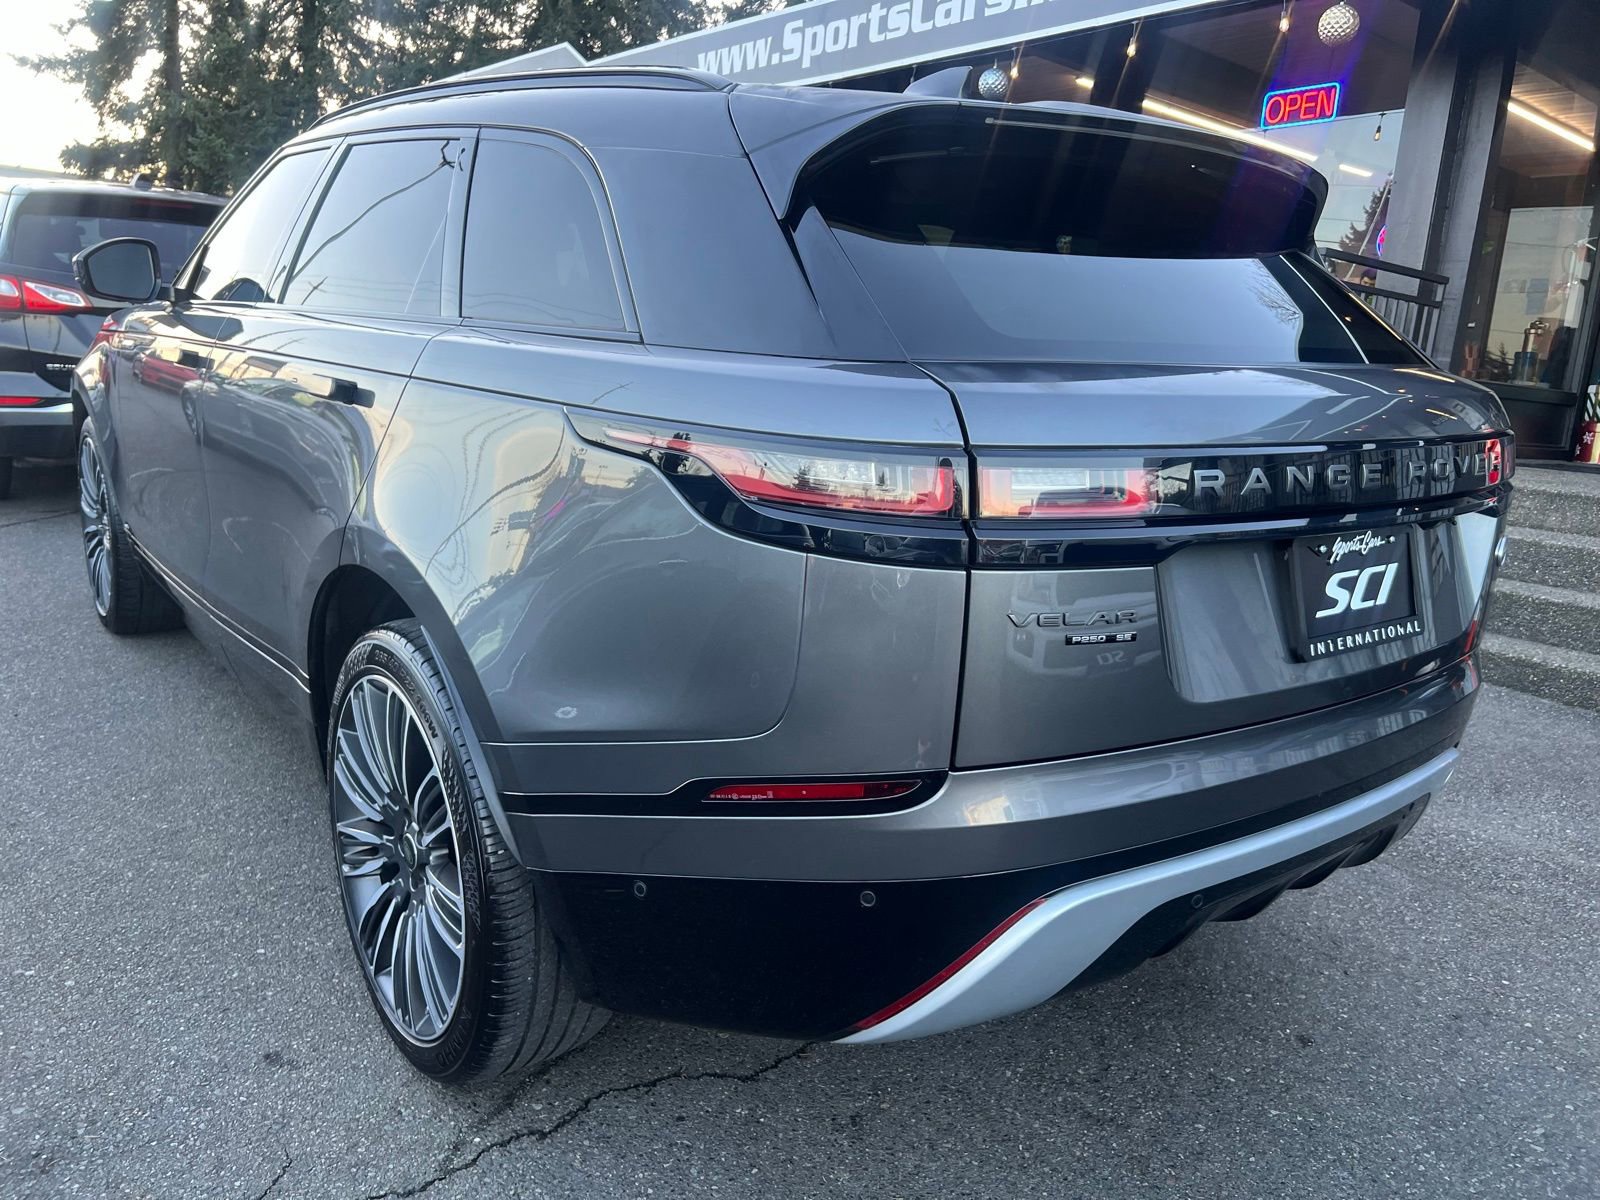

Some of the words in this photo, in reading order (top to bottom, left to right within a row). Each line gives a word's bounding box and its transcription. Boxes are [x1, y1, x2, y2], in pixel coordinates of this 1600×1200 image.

[698, 0, 1053, 75] www.SportsCar
[1266, 88, 1336, 124] OPEN
[1193, 463, 1382, 497] RANGE
[1315, 562, 1399, 618] SCI
[1007, 609, 1138, 628] VELAR
[1072, 635, 1106, 644] P250
[1116, 633, 1132, 641] SE
[1310, 620, 1421, 656] INTERNATIONAL
